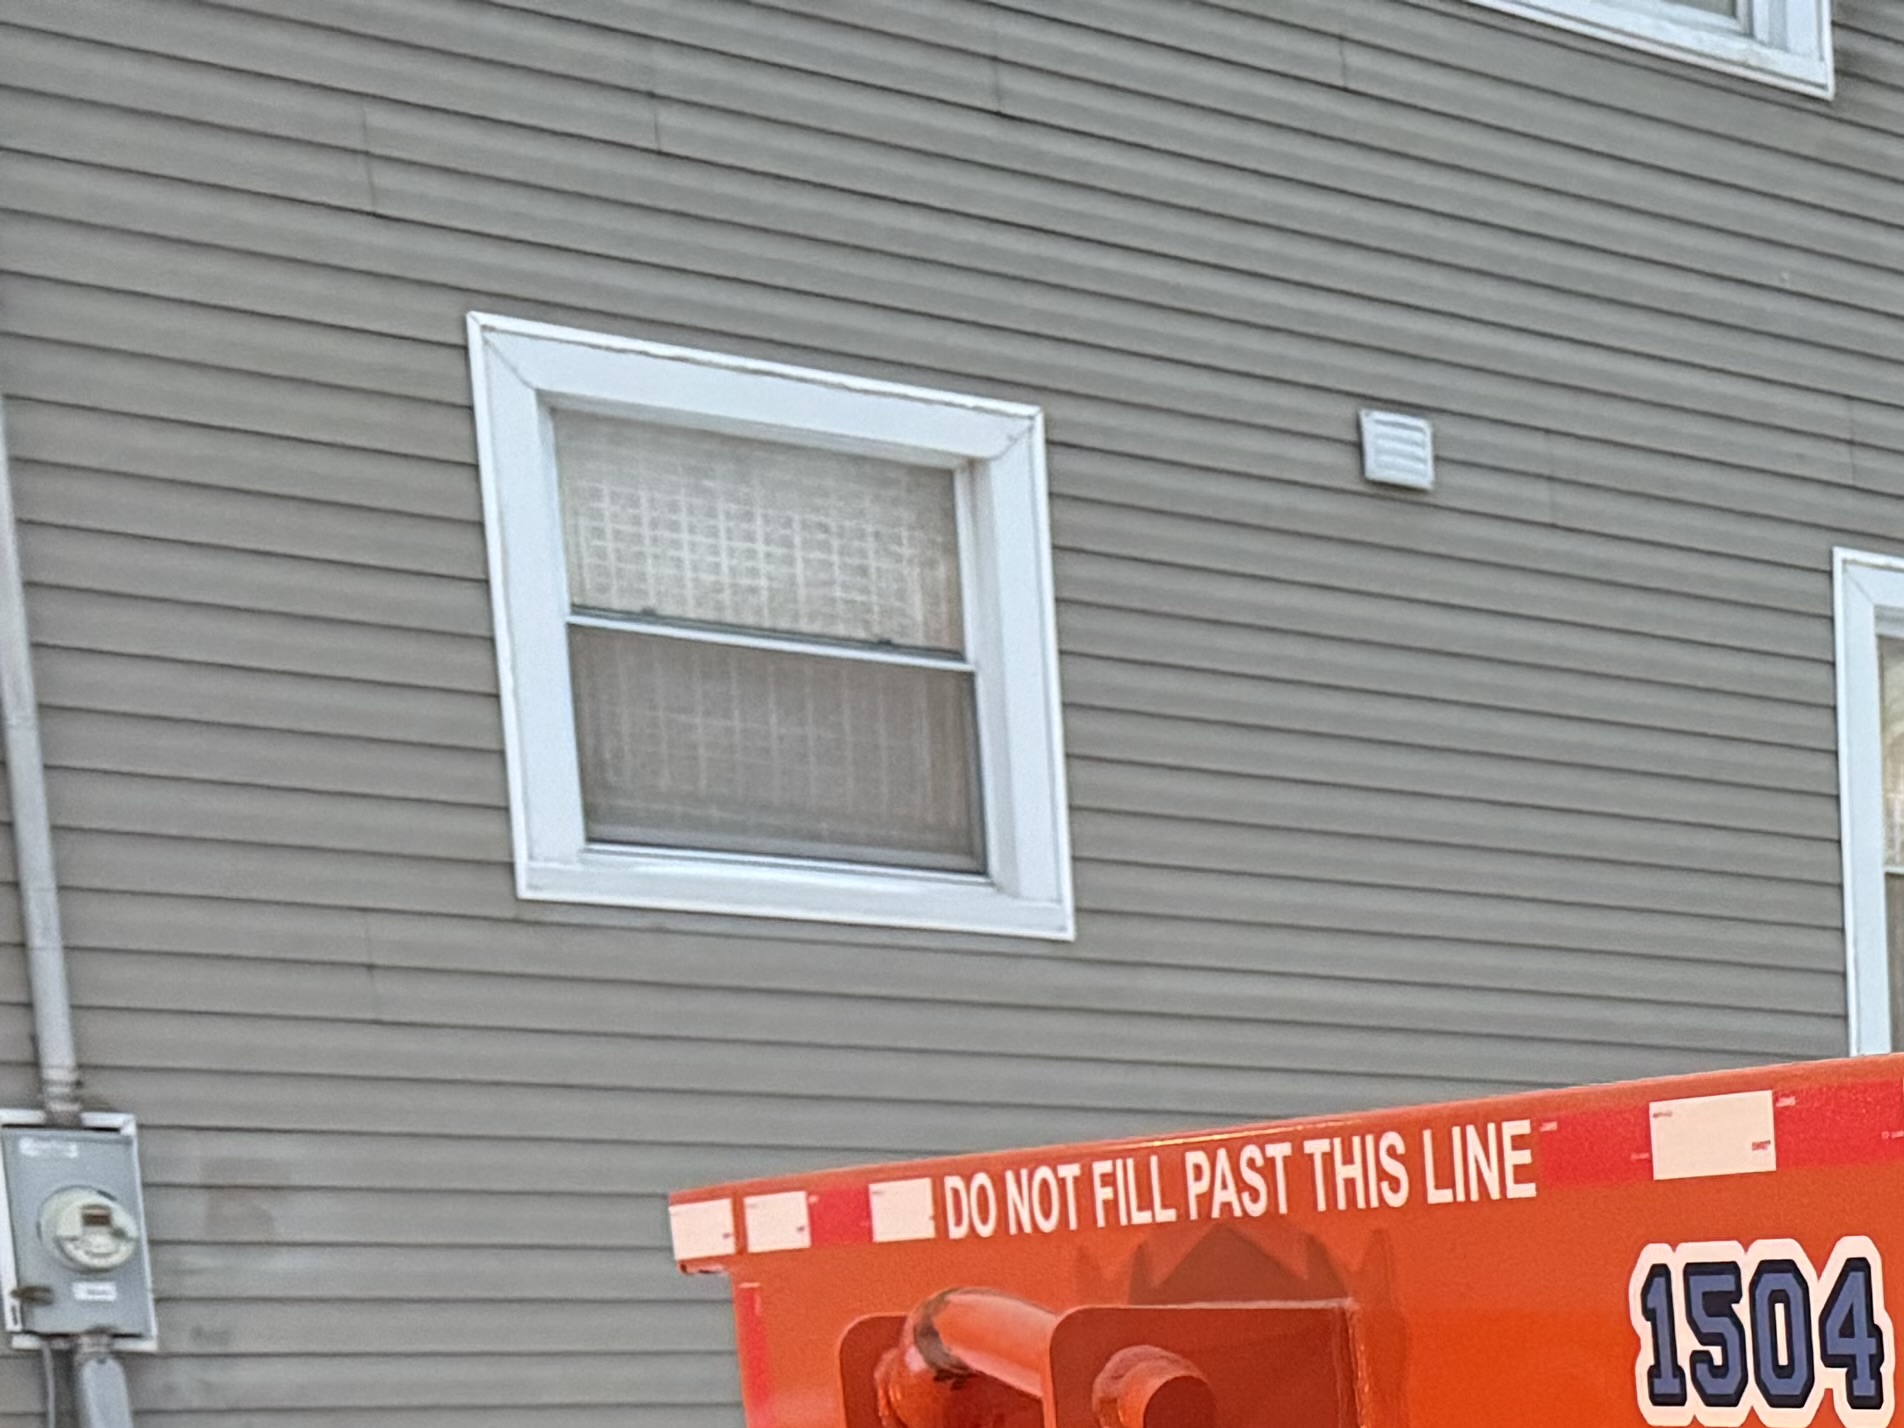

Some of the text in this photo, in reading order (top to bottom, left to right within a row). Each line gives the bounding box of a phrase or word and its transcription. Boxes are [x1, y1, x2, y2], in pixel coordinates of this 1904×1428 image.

[944, 1119, 1537, 1240] DO NOT FILL PAST THIS LINE
[1641, 1256, 1885, 1410] 1504
